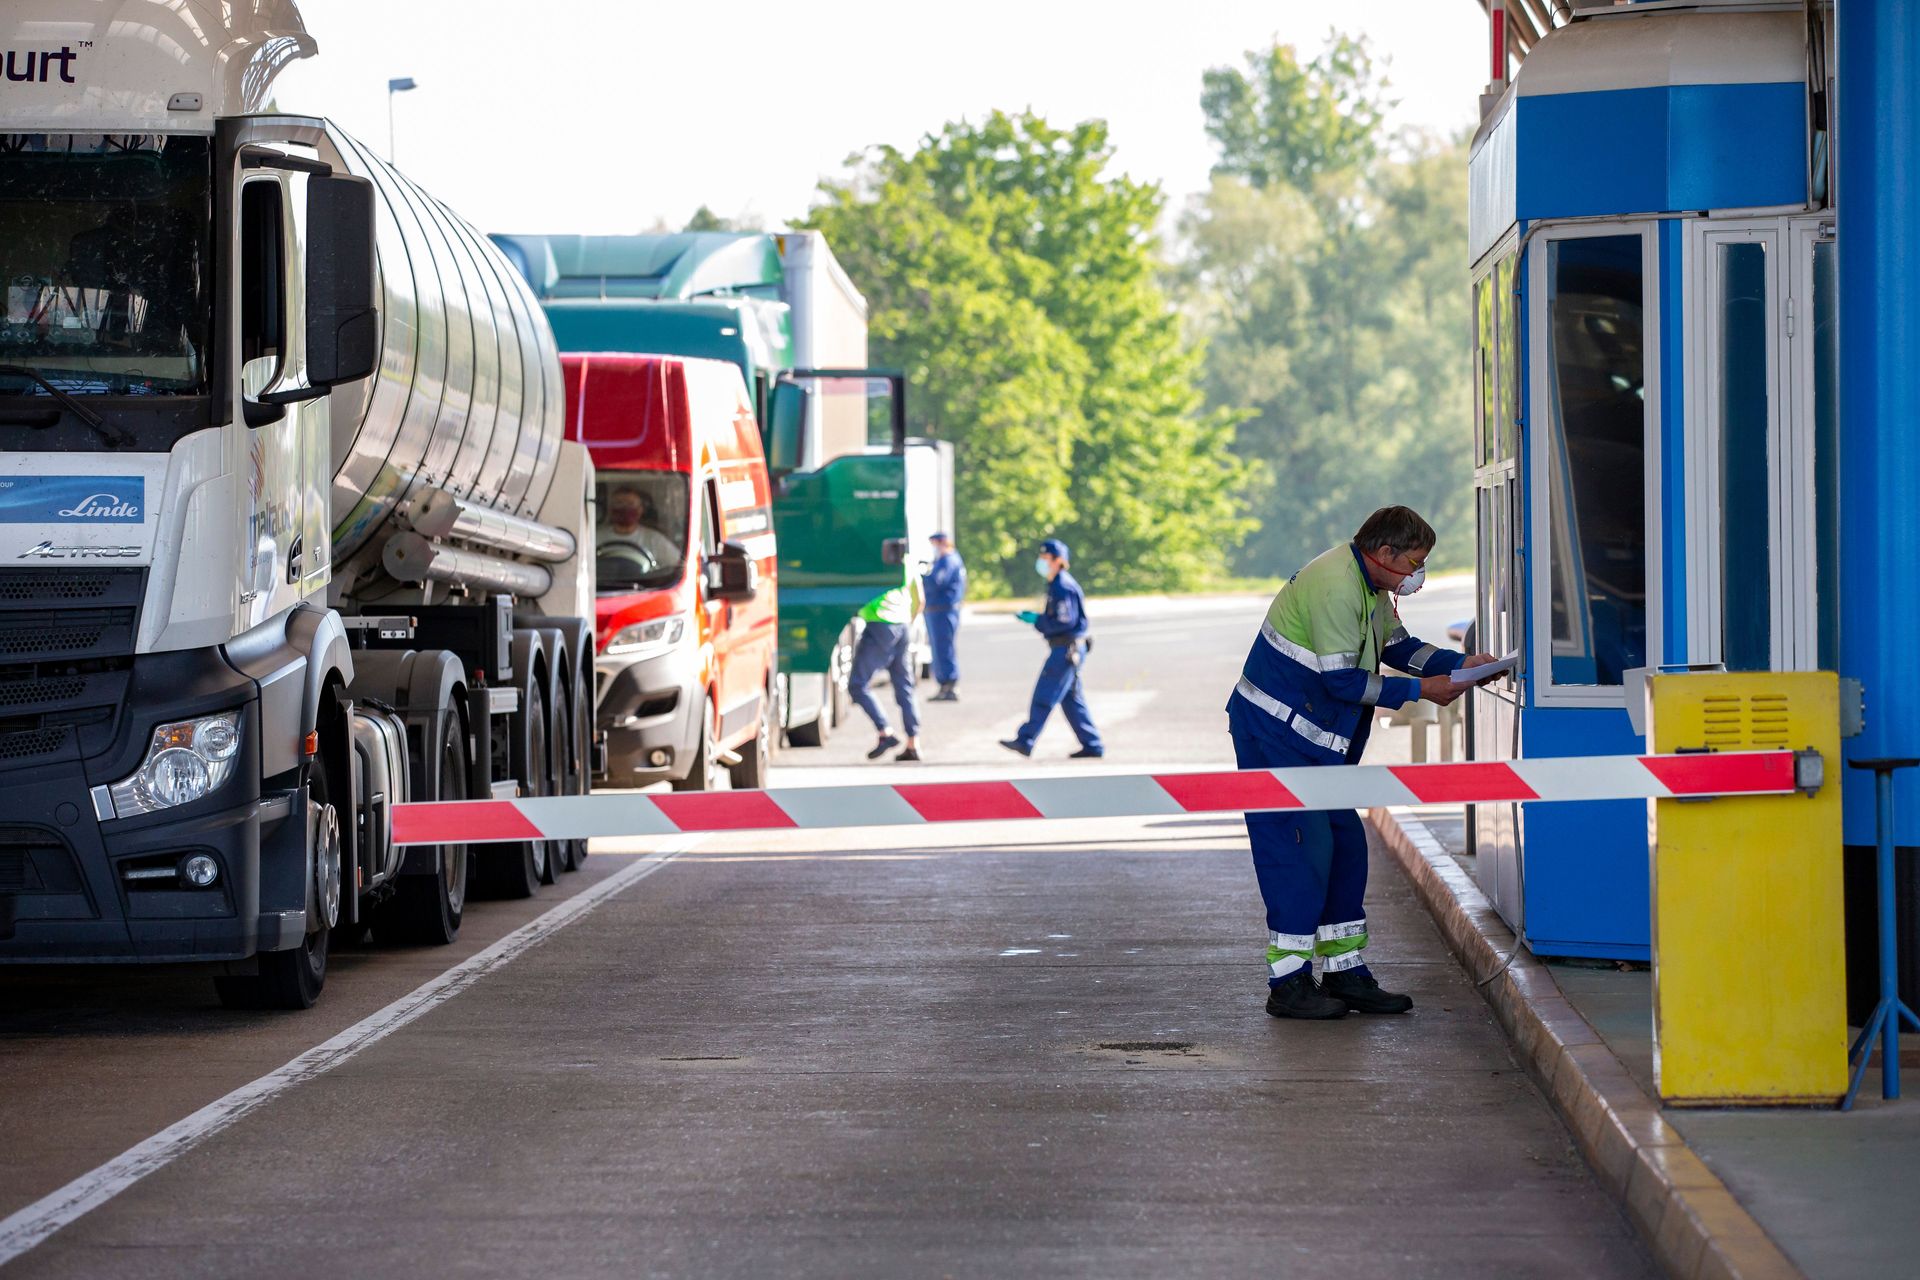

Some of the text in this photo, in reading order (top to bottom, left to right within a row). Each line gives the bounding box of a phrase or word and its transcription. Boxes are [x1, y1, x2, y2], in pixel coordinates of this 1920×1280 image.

[0, 46, 77, 83] urt
[58, 493, 139, 517] Linde
[17, 540, 142, 559] ACTROS
